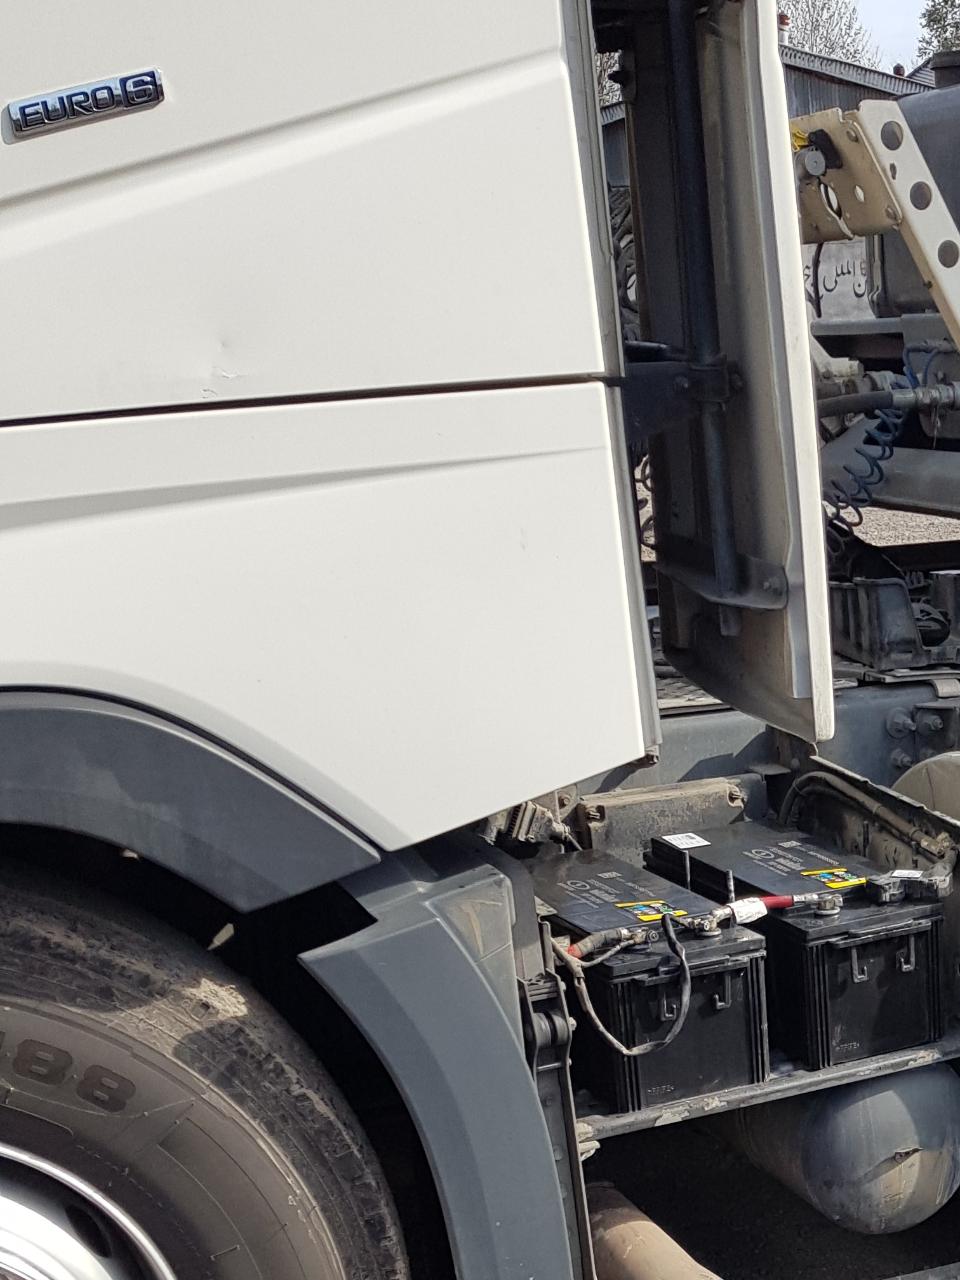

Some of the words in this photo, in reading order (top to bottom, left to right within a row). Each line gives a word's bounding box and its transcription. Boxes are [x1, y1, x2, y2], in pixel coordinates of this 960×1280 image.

[18, 85, 118, 131] EURO
[123, 73, 157, 104] 6
[0, 1030, 137, 1113] 88
